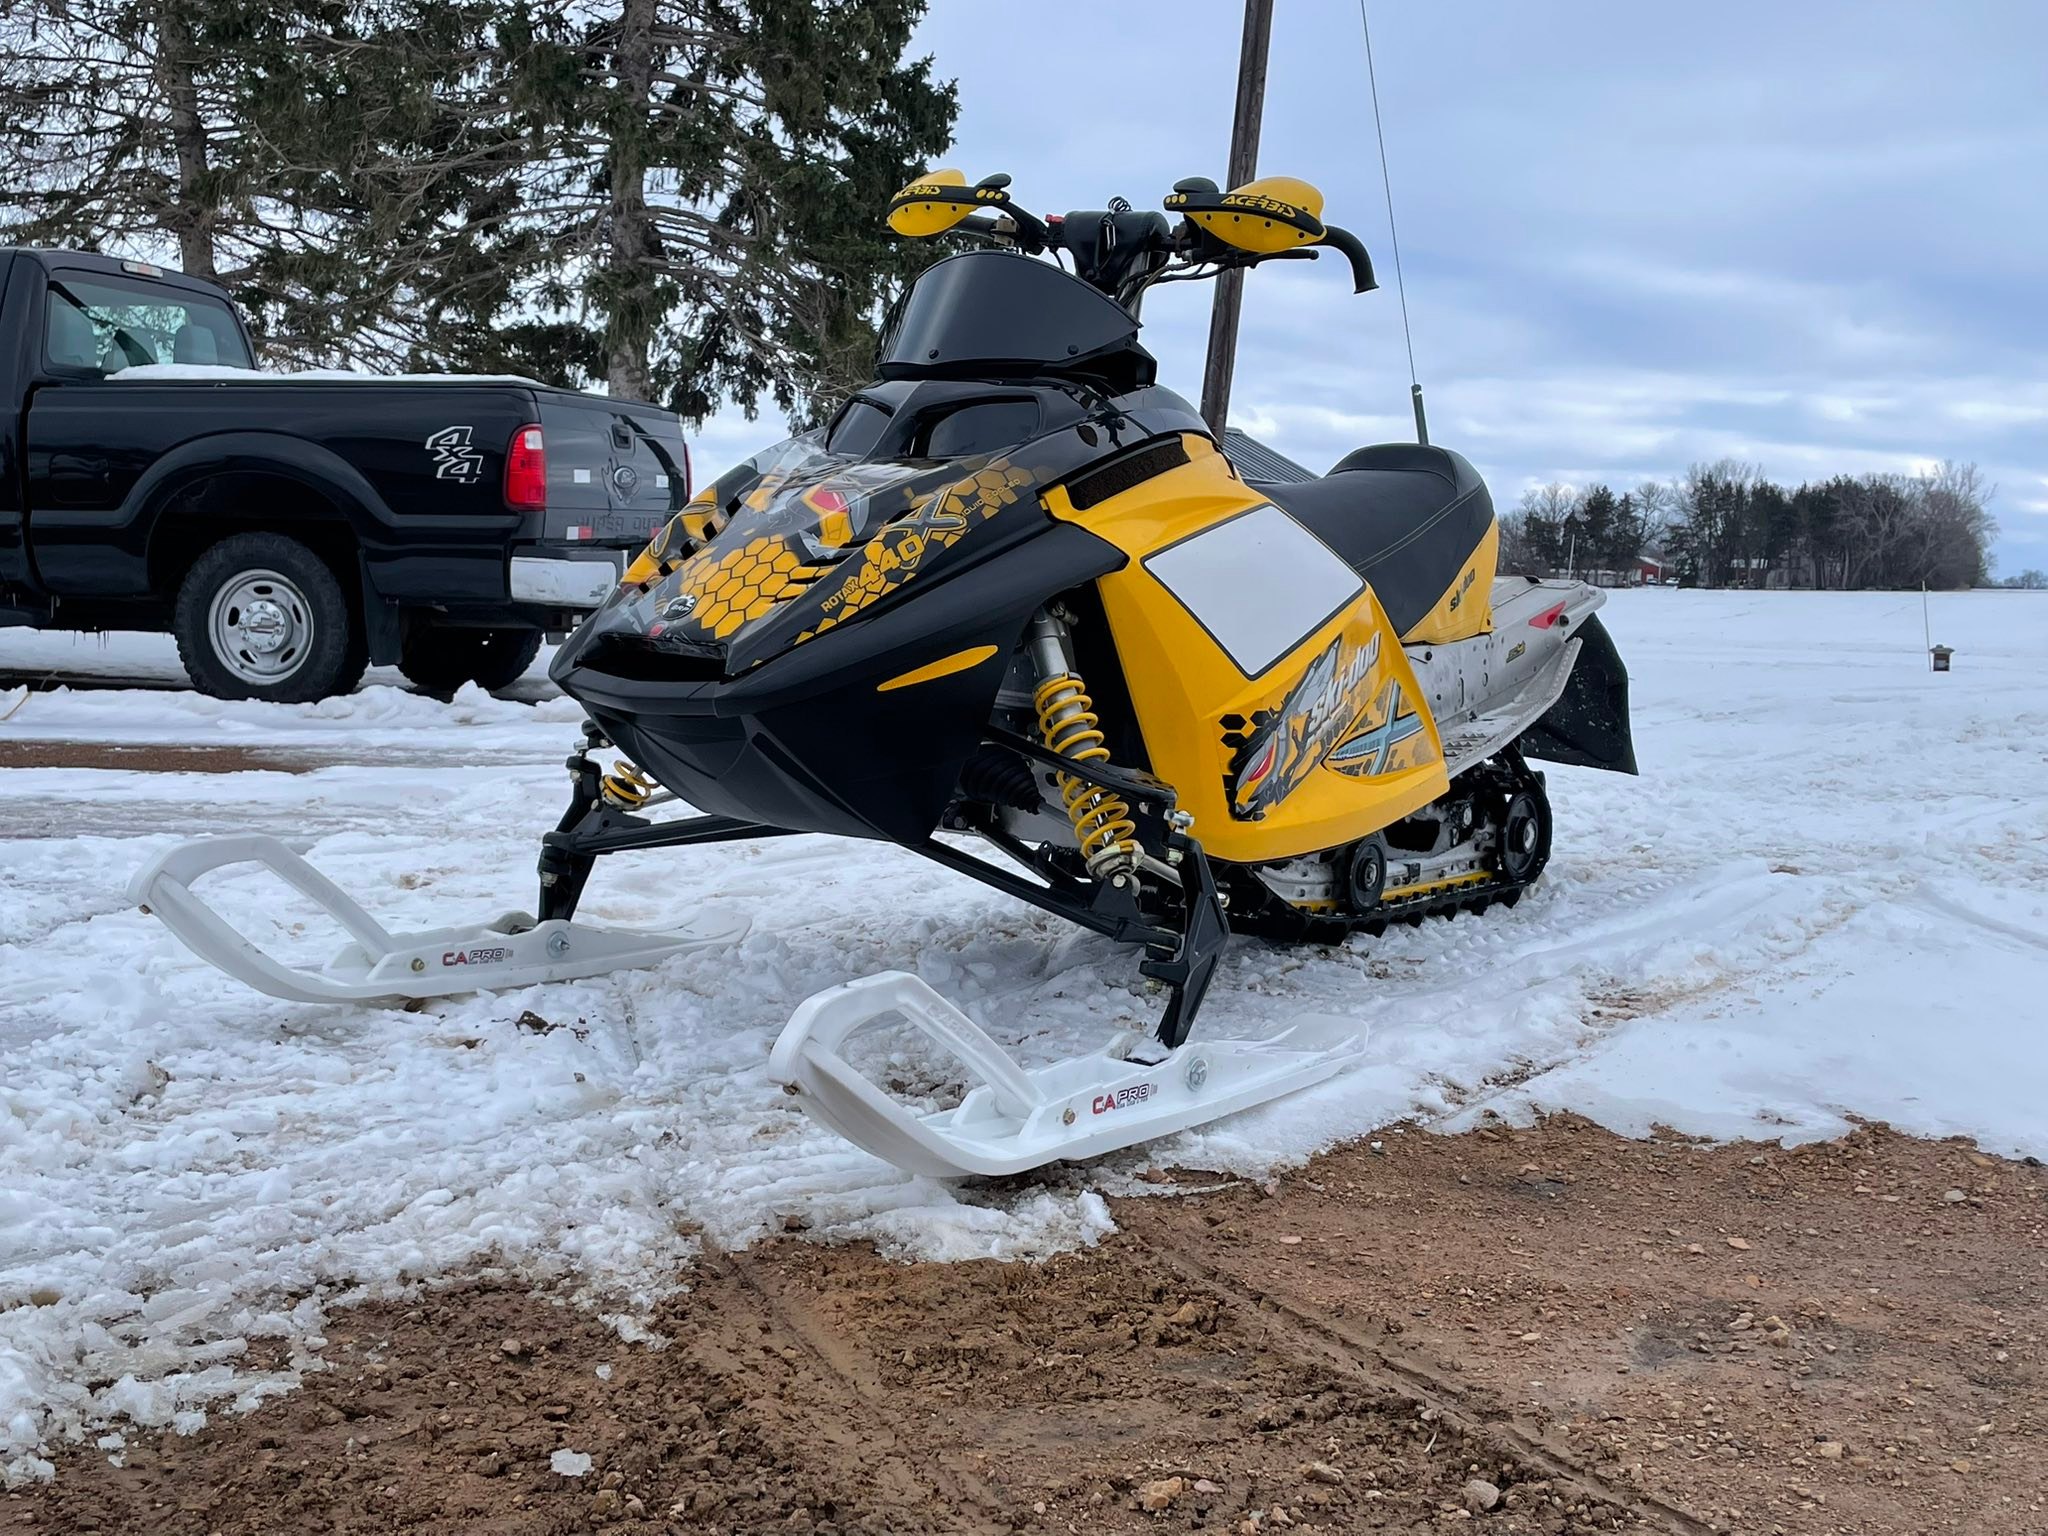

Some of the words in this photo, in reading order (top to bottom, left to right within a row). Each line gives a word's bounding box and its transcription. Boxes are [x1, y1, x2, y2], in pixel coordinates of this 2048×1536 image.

[1220, 194, 1297, 219] ACERBIS
[985, 478, 1021, 500] COOLED
[820, 576, 859, 613] ROTAX
[858, 533, 926, 589] 440
